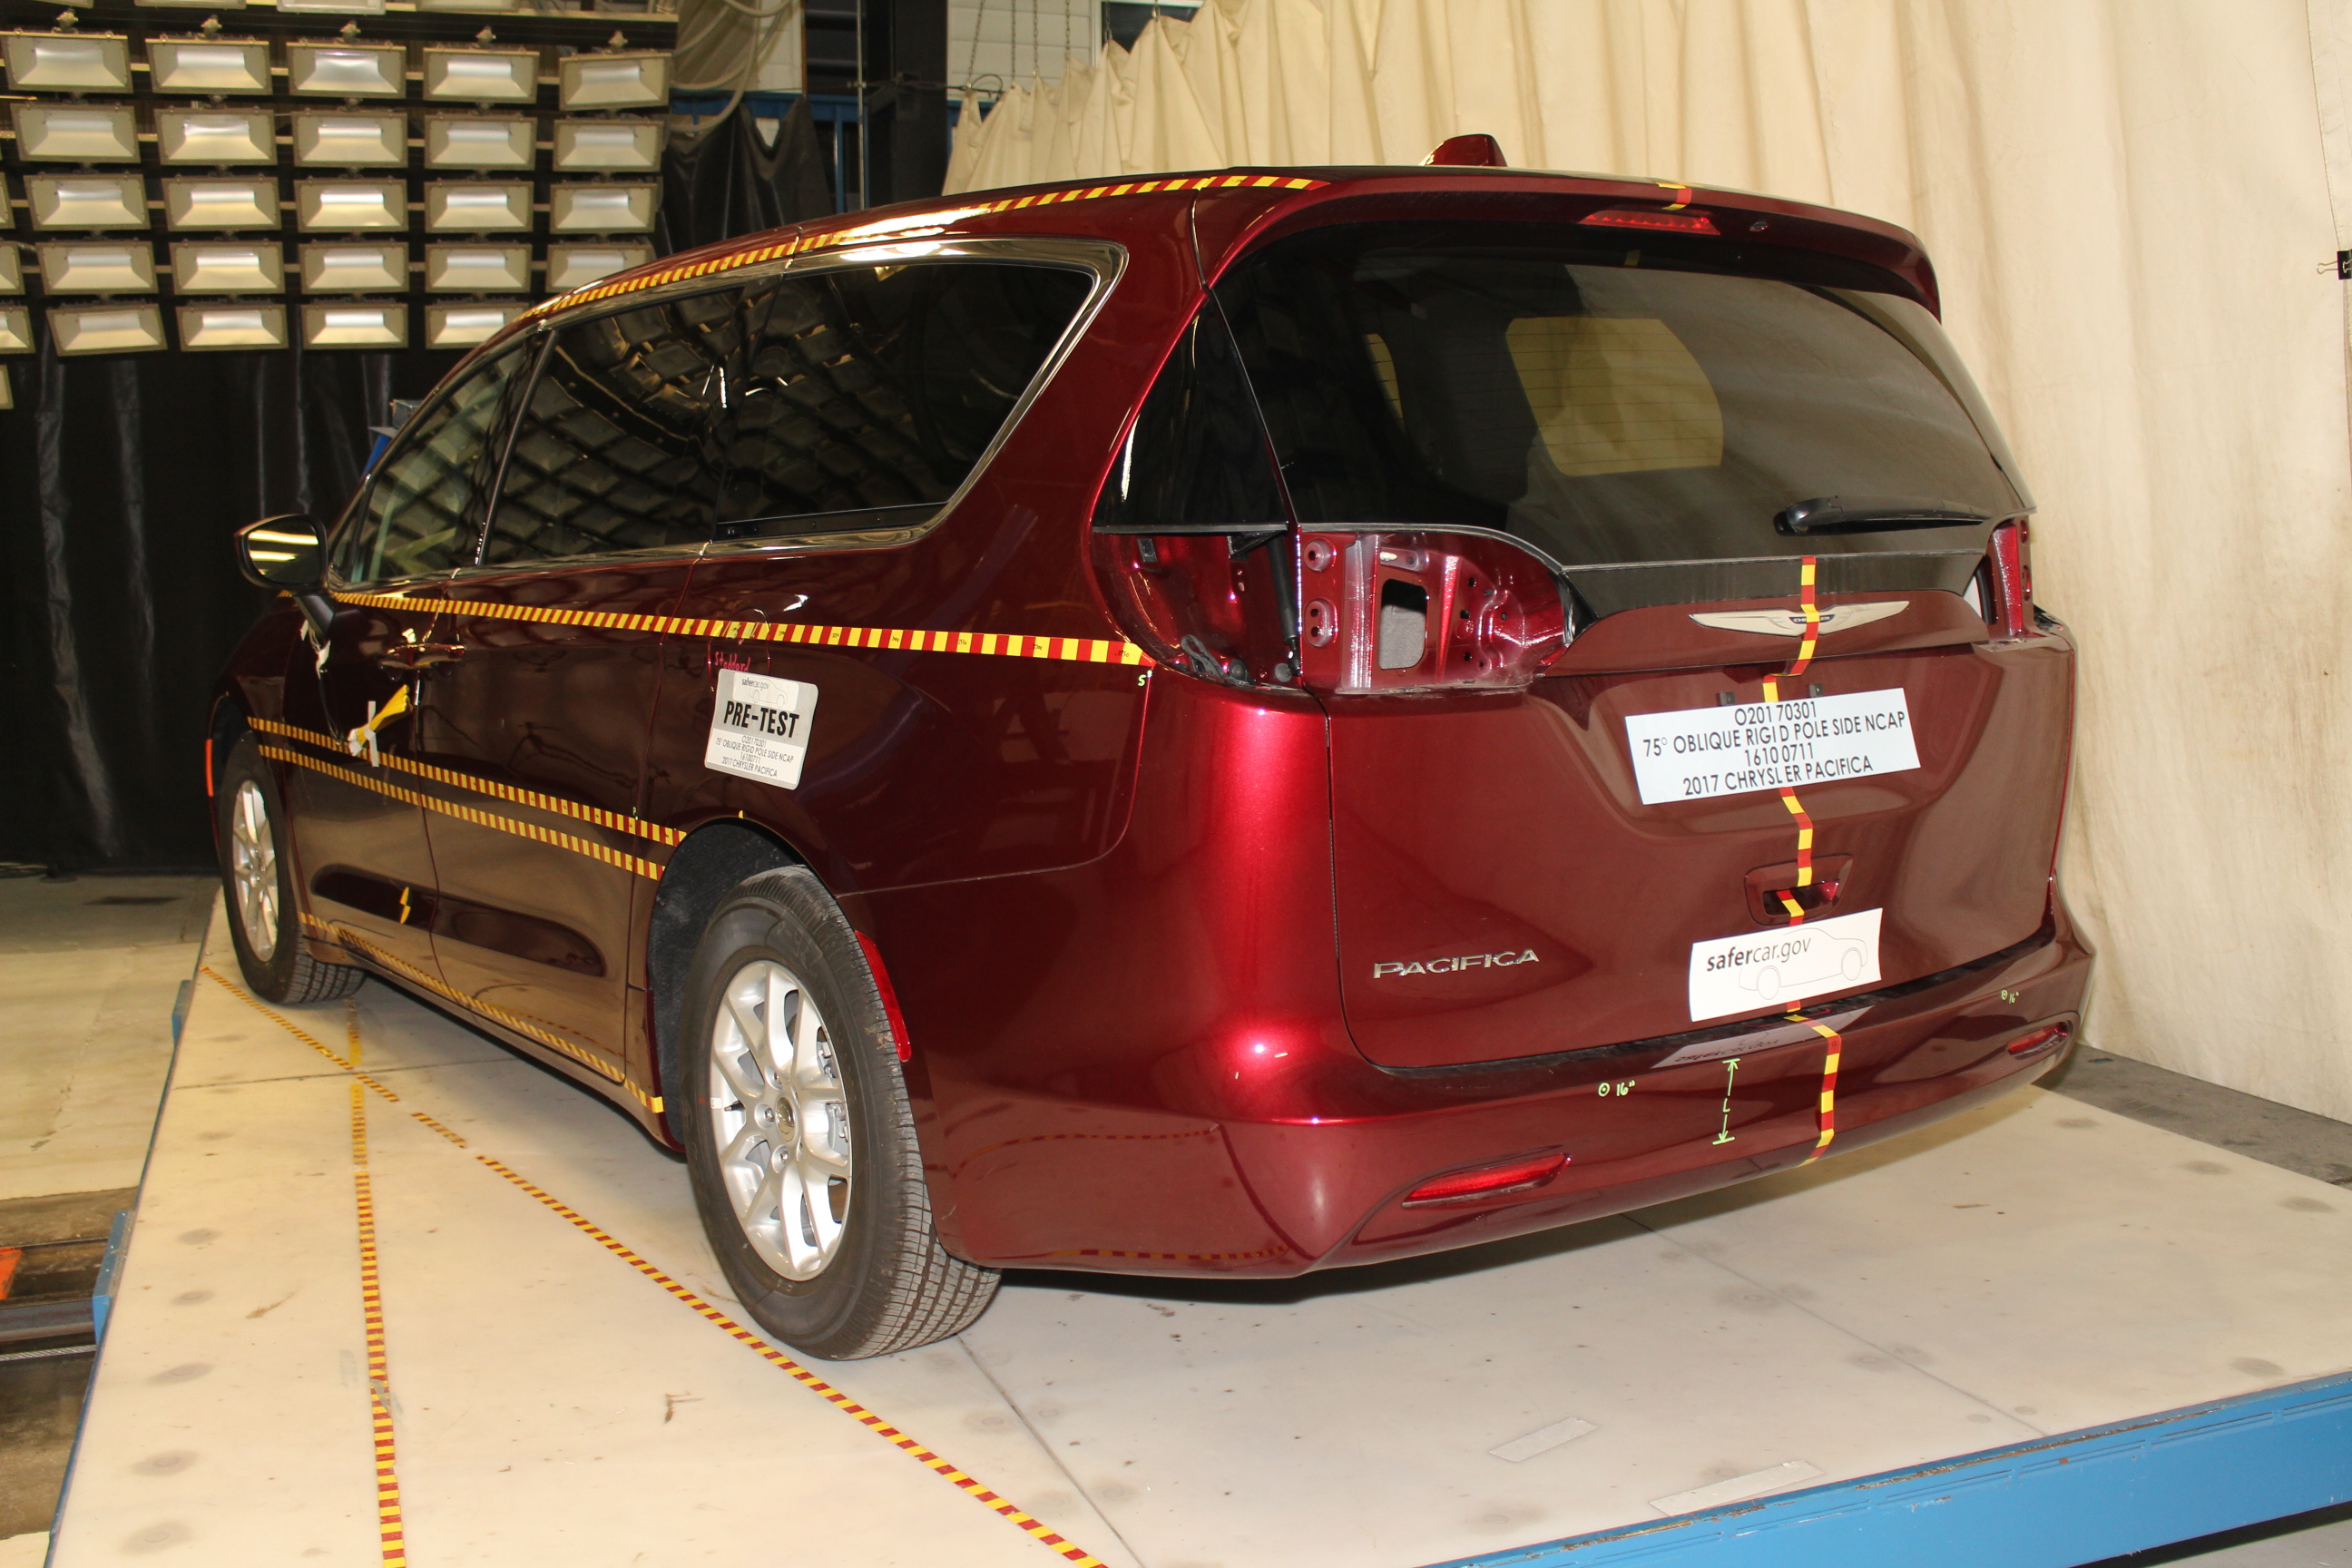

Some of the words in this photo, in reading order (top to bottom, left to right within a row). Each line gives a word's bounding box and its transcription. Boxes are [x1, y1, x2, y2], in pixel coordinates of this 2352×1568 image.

[741, 677, 769, 691] safercar.gov
[723, 701, 800, 738] PRE-TEST
[1642, 737, 1667, 757] 75°
[1673, 730, 1741, 754] OBLIQUE
[1746, 725, 1789, 746] RIGID
[1794, 720, 1828, 740] POLE
[1832, 716, 1861, 736] SIDE
[1865, 711, 1906, 731] NCAP
[721, 756, 733, 766] 2017
[732, 759, 754, 771] CHRYSLER
[754, 764, 778, 778] PACIFICA
[722, 739, 741, 751] OBLIQUE
[741, 744, 755, 754] RIGID
[755, 747, 768, 758] POLE
[767, 750, 779, 760] SIDE
[779, 753, 794, 763] NCAP
[1682, 774, 1719, 796] 2017
[1725, 765, 1802, 790] CHRYSLER
[1806, 755, 1874, 780] PACIFICA
[1373, 948, 1540, 979] PACIFICA
[1707, 937, 1811, 972] safercar.gov
